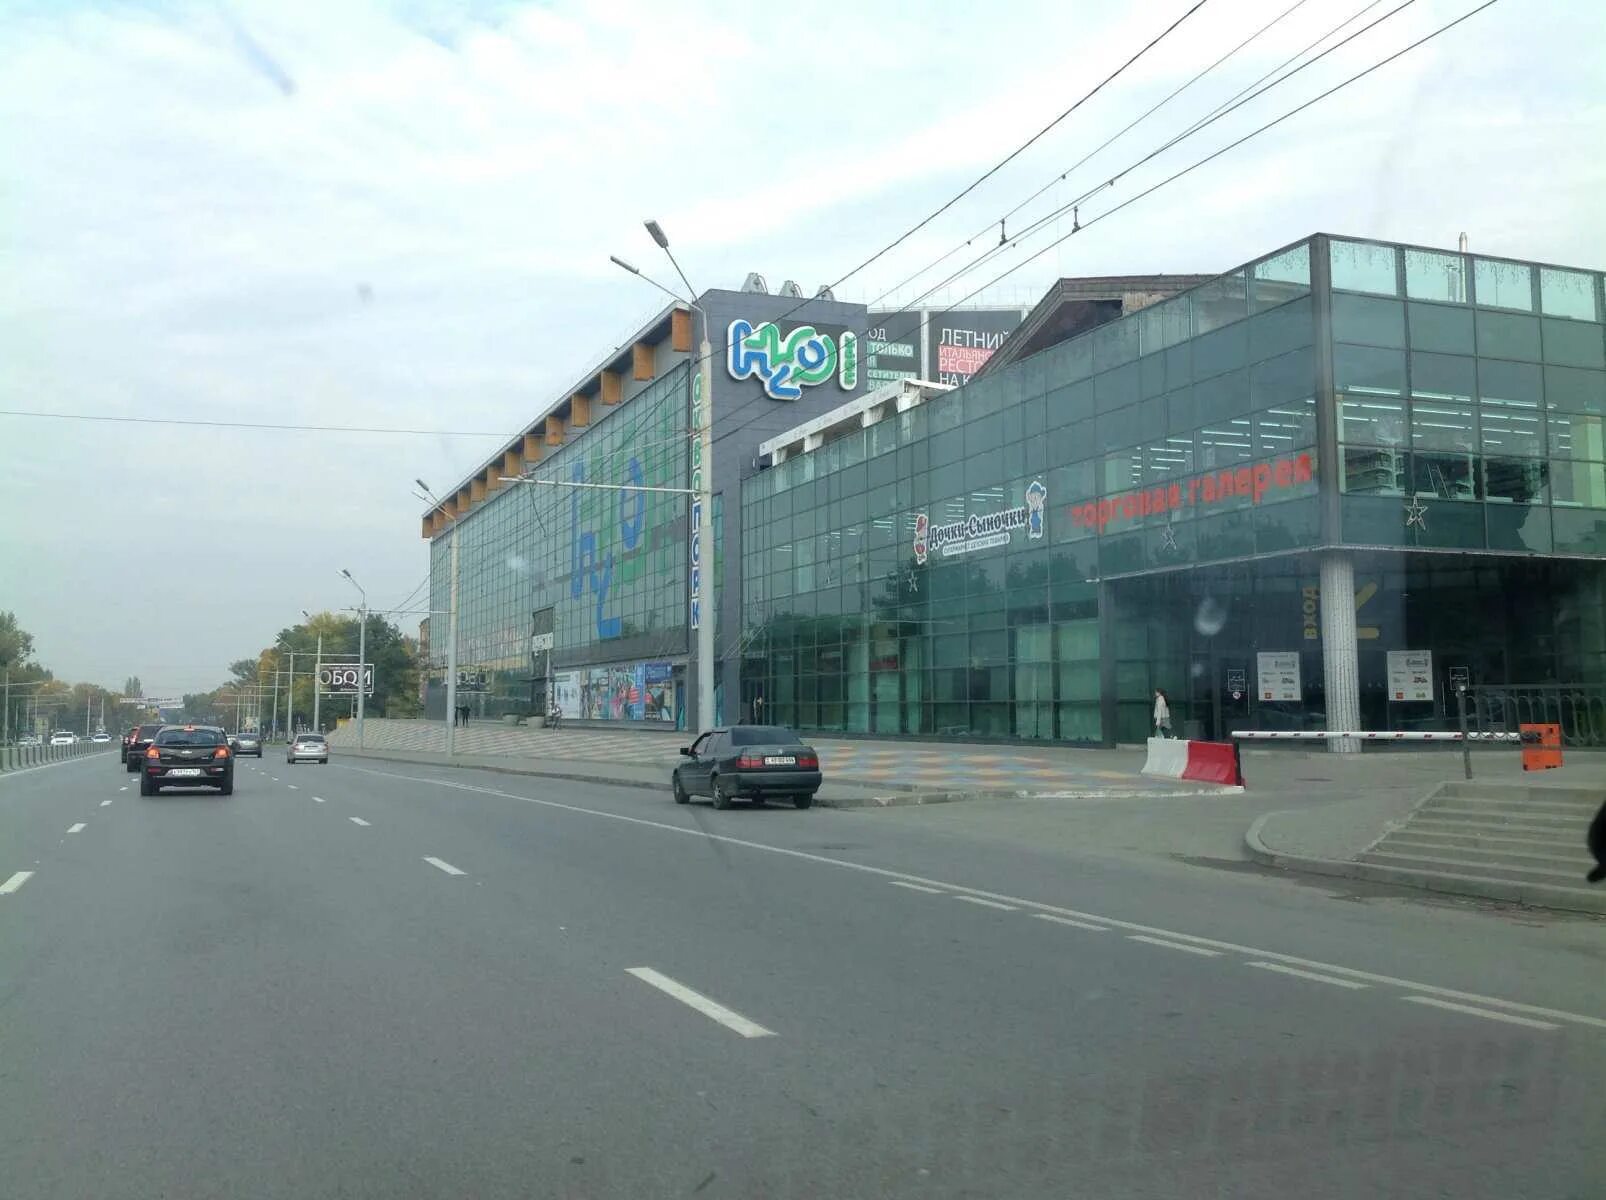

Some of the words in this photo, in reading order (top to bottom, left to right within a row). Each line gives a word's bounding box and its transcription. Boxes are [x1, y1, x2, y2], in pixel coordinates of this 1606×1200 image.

[867, 328, 886, 341] ОД
[939, 345, 995, 360] ИТАЛЬЯНС
[939, 373, 959, 387] НА
[1072, 483, 1182, 535] торговая
[1188, 453, 1313, 505] галерея
[930, 506, 1027, 551] Дочки-Сыночки
